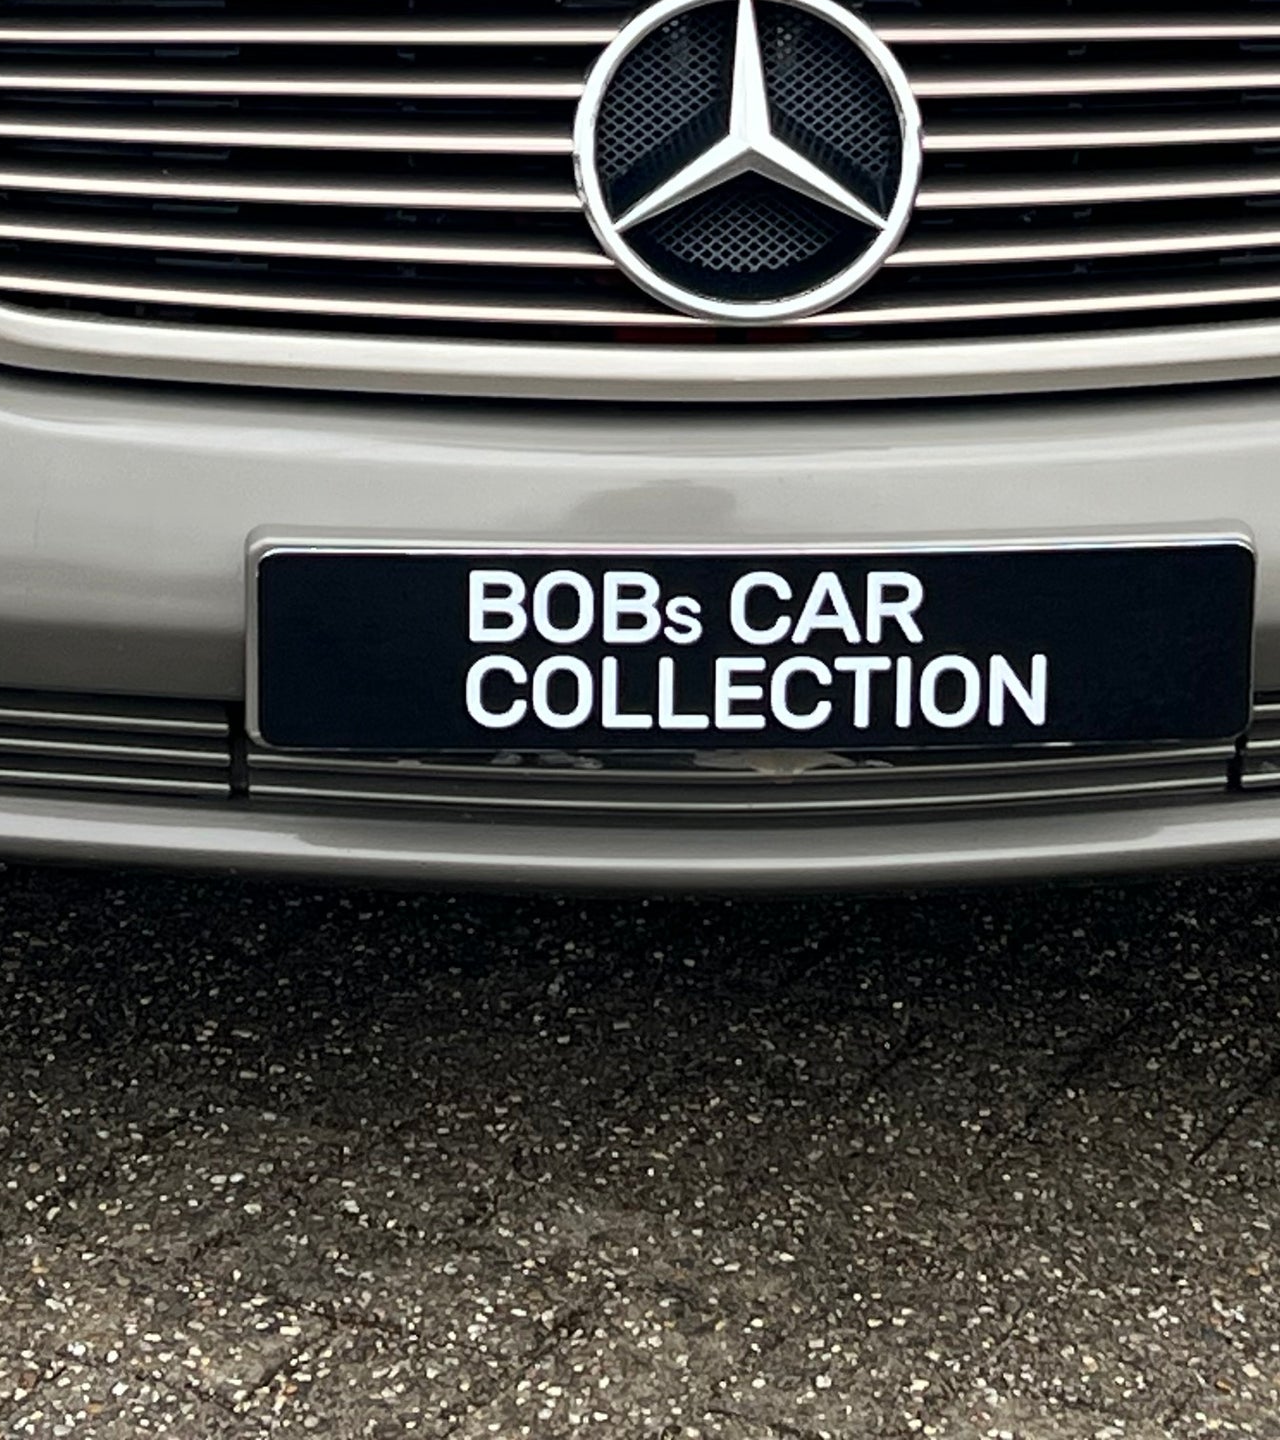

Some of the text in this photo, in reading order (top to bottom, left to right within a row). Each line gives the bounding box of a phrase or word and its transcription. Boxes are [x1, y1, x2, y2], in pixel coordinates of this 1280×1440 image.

[468, 569, 924, 645] BOBs CAR
[465, 654, 1049, 730] COLLECTION
